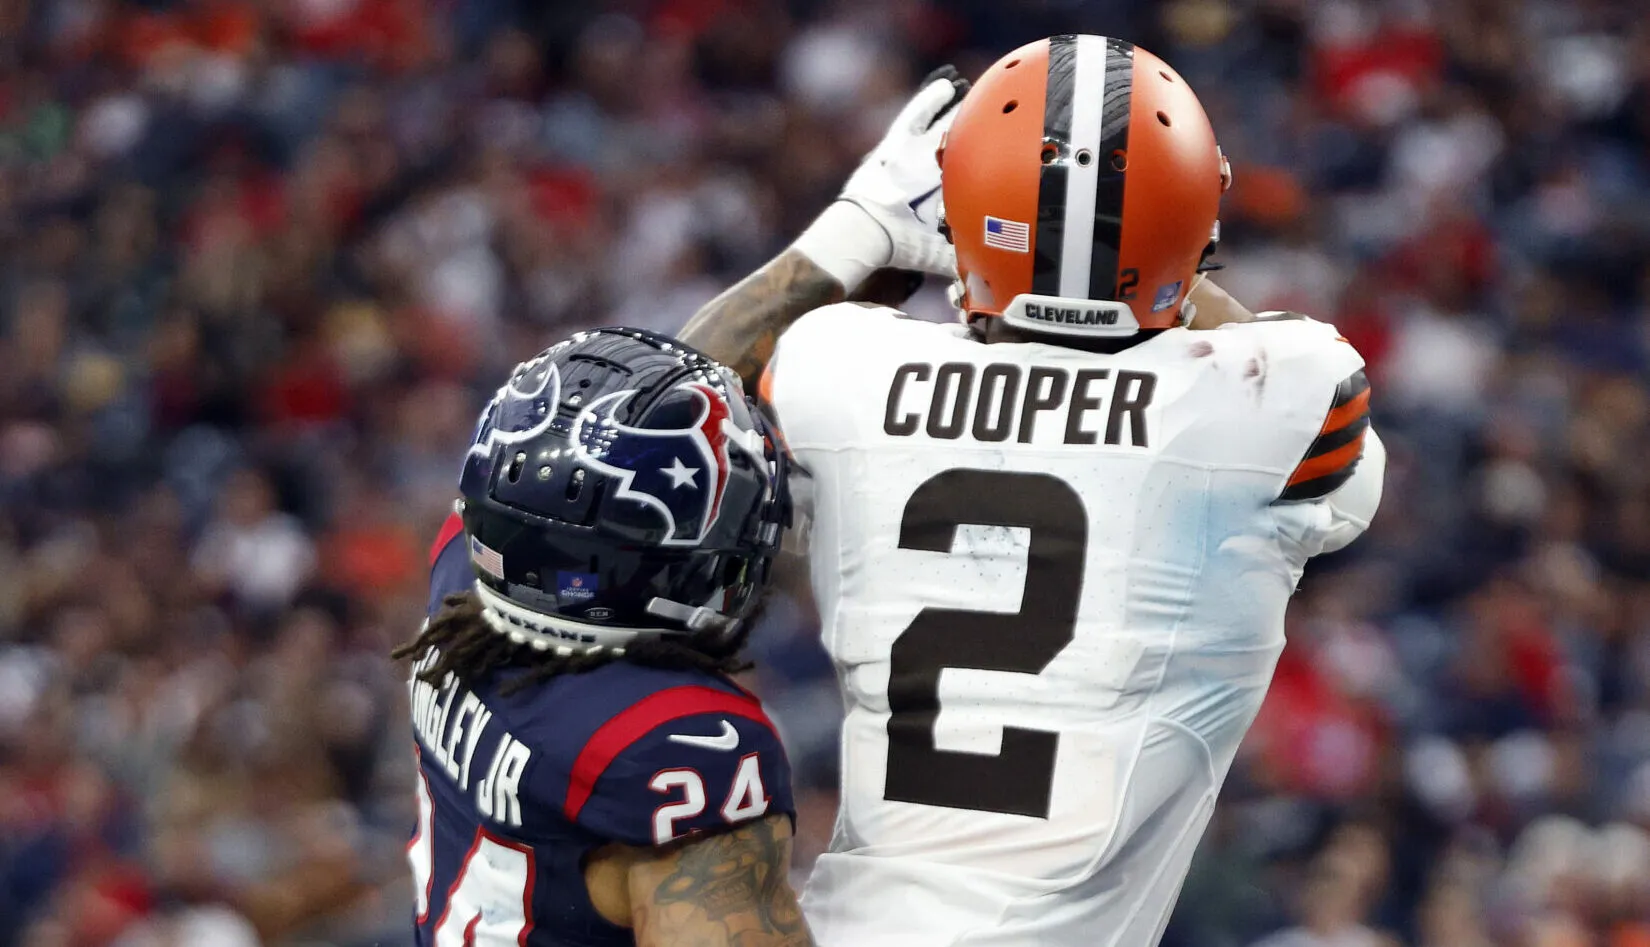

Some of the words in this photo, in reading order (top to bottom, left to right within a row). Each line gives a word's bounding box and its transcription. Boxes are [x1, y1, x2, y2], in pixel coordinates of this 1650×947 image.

[1025, 303, 1119, 325] CLEVELAND
[1118, 268, 1140, 301] 2
[884, 362, 1158, 448] COOPER
[884, 467, 1089, 820] 2
[476, 732, 531, 828] JR
[648, 752, 772, 848] 24
